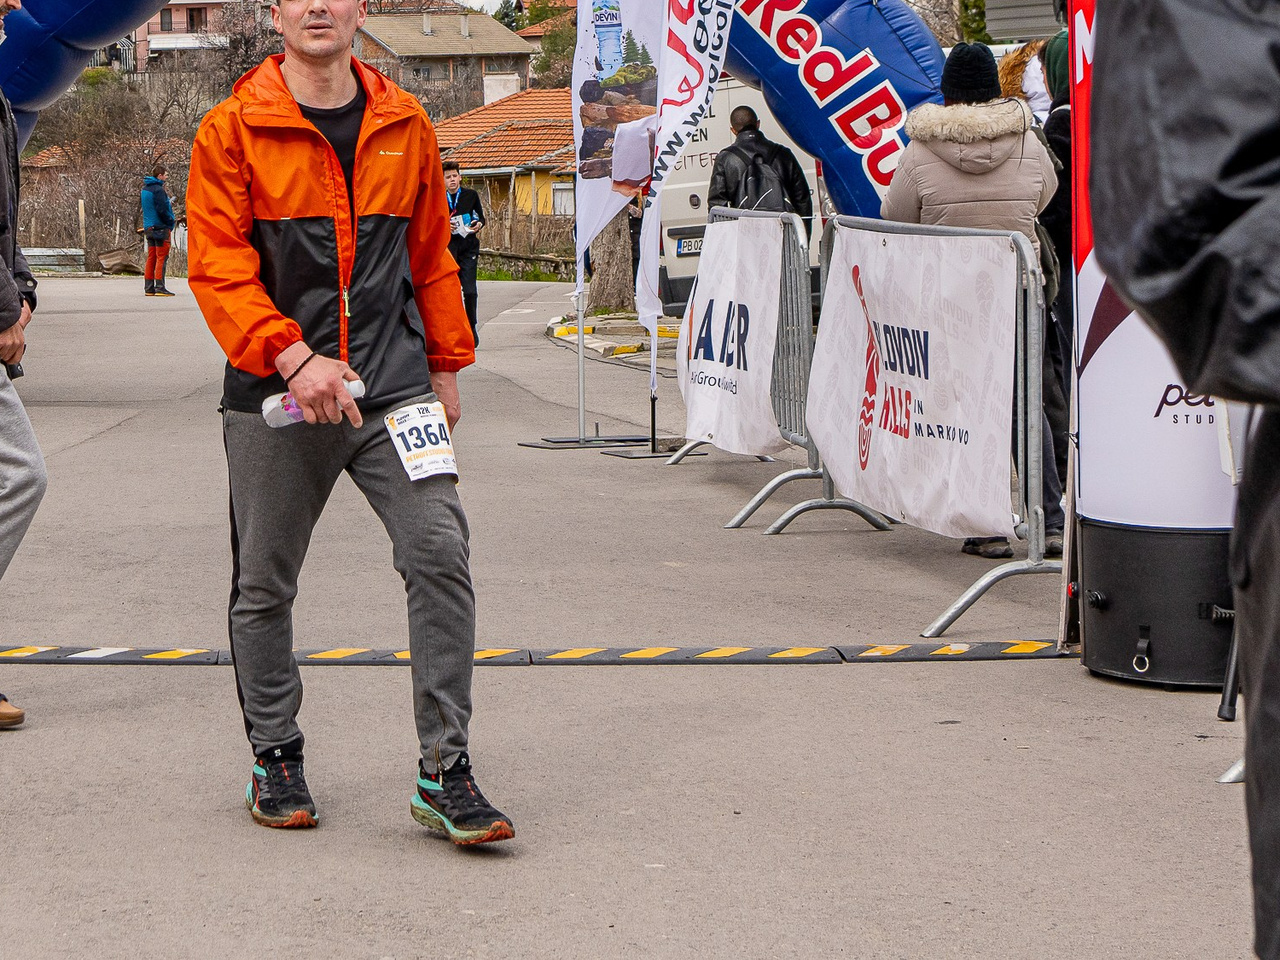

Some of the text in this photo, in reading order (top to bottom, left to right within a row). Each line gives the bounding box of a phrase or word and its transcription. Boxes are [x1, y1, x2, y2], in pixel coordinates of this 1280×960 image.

[595, 11, 618, 22] DEVIN
[834, 85, 903, 186] Bu
[914, 399, 924, 415] IN
[1173, 414, 1214, 424] STUD
[396, 422, 450, 453] 1364
